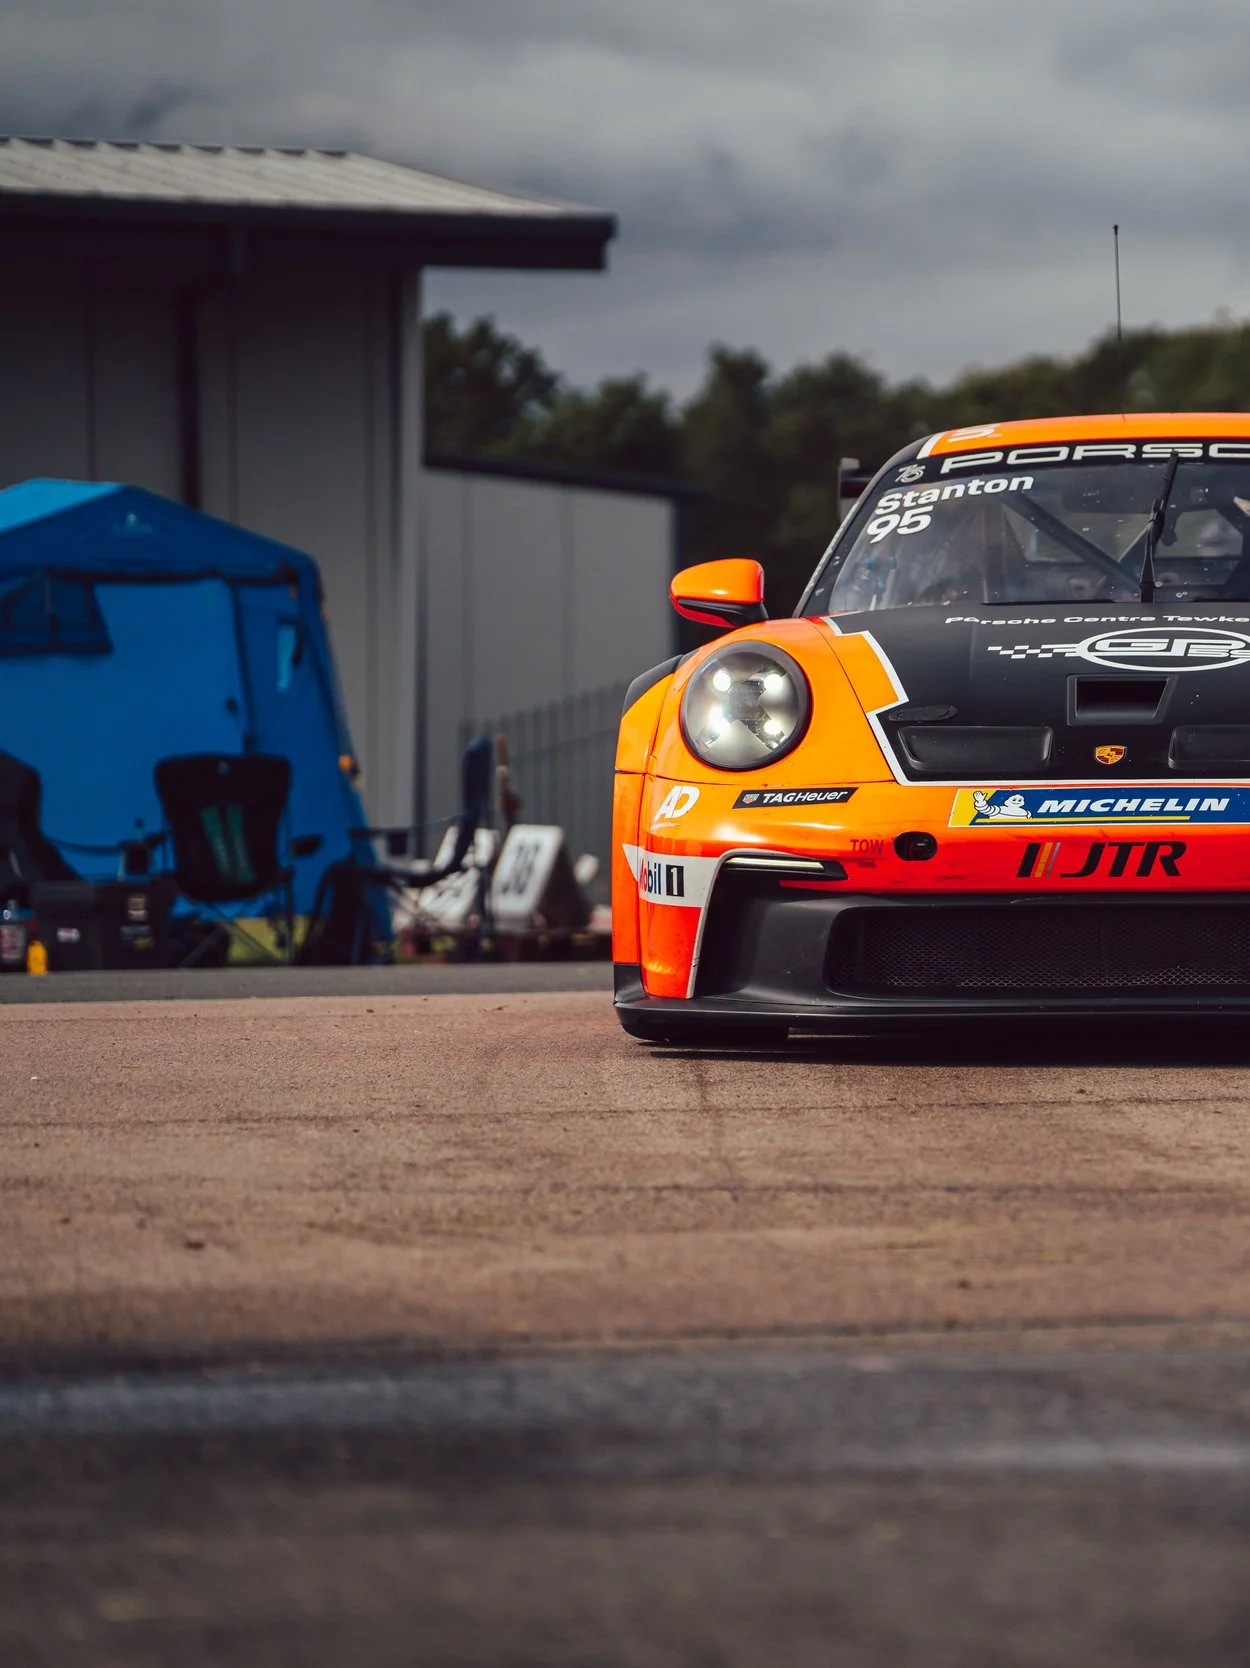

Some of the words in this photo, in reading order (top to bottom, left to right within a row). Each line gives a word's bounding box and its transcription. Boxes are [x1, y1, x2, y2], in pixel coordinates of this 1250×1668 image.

[875, 475, 1035, 516] Stanton
[866, 504, 934, 545] 95
[945, 616, 1057, 625] Porsche
[1063, 615, 1156, 623] Centre
[1037, 798, 1231, 814] MICHELIN
[850, 838, 885, 855] TOW
[1059, 841, 1188, 879] JTR
[639, 858, 662, 895] Mobil
